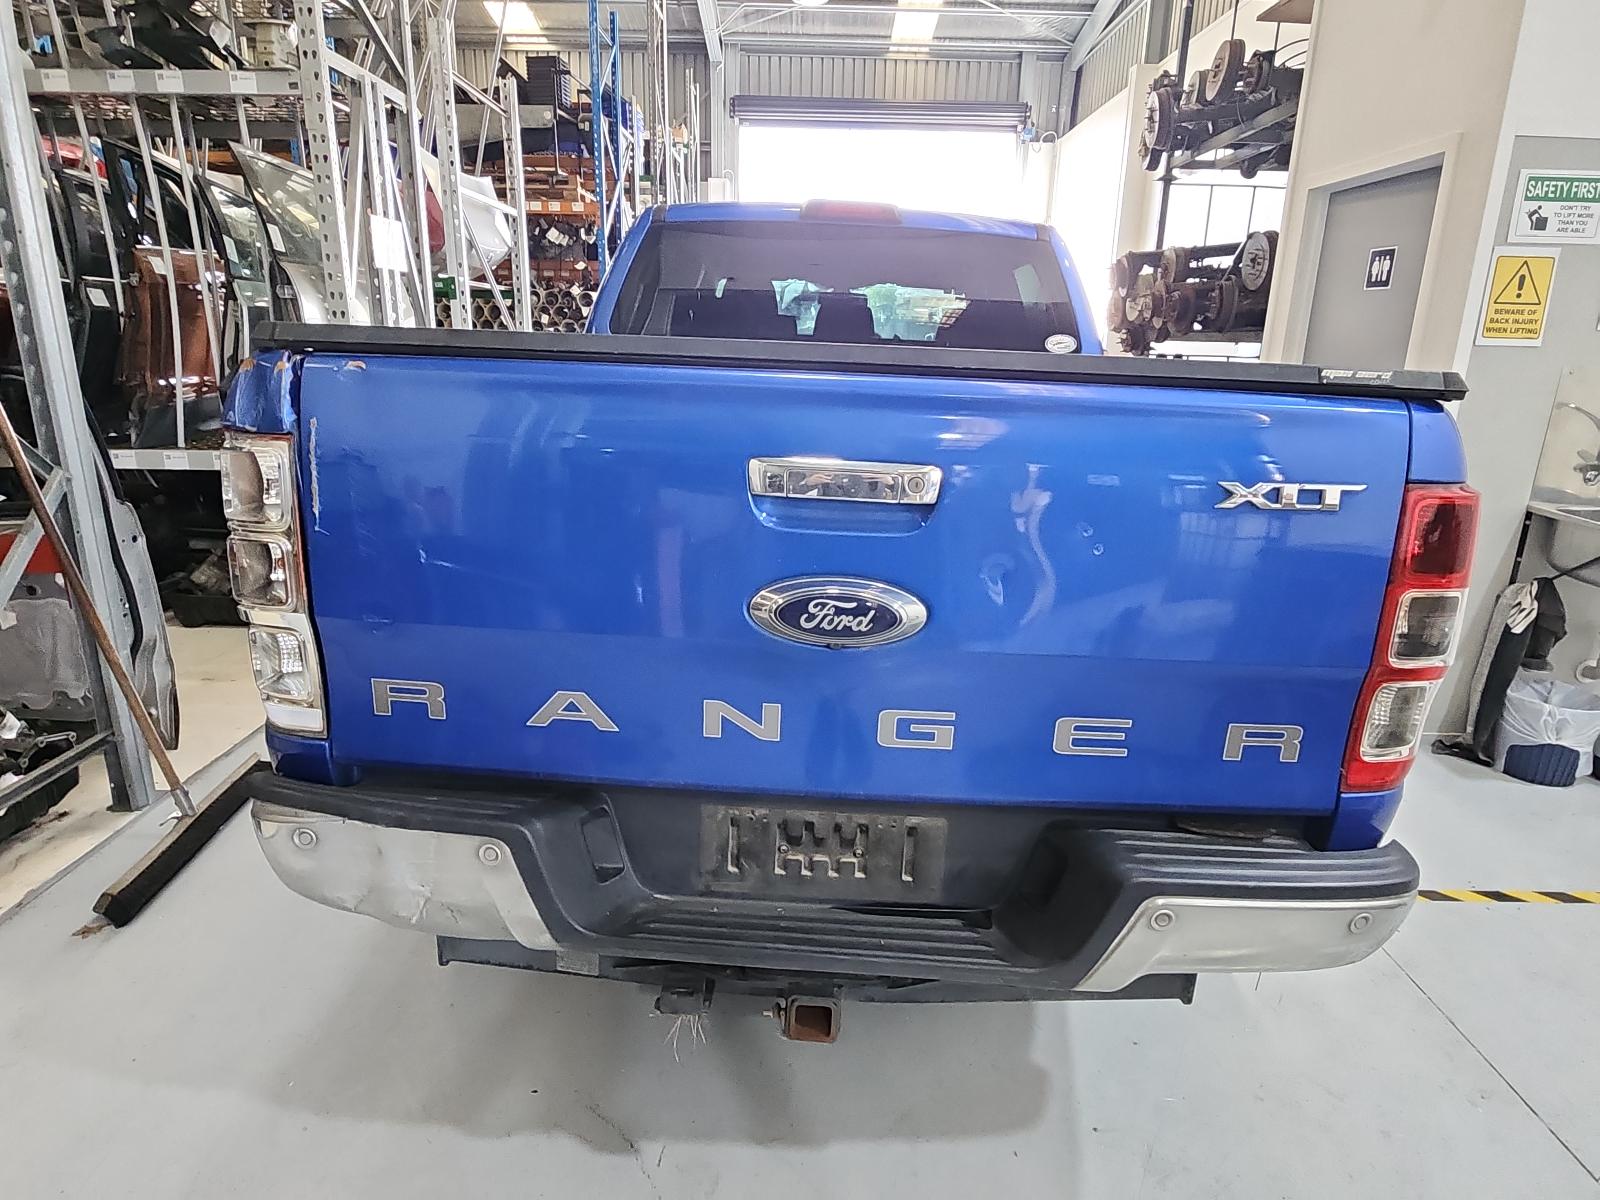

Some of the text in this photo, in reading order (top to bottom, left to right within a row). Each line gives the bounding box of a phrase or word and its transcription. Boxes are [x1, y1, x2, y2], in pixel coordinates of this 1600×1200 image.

[1526, 180, 1571, 198] SAFETY
[1494, 308, 1526, 316] BEWARE
[1485, 326, 1538, 335] WHEN LIFTING
[1489, 317, 1540, 326] BACK INJURY
[1214, 481, 1368, 512] XLT
[800, 598, 876, 632] Ford
[370, 677, 1305, 764] RANGER
